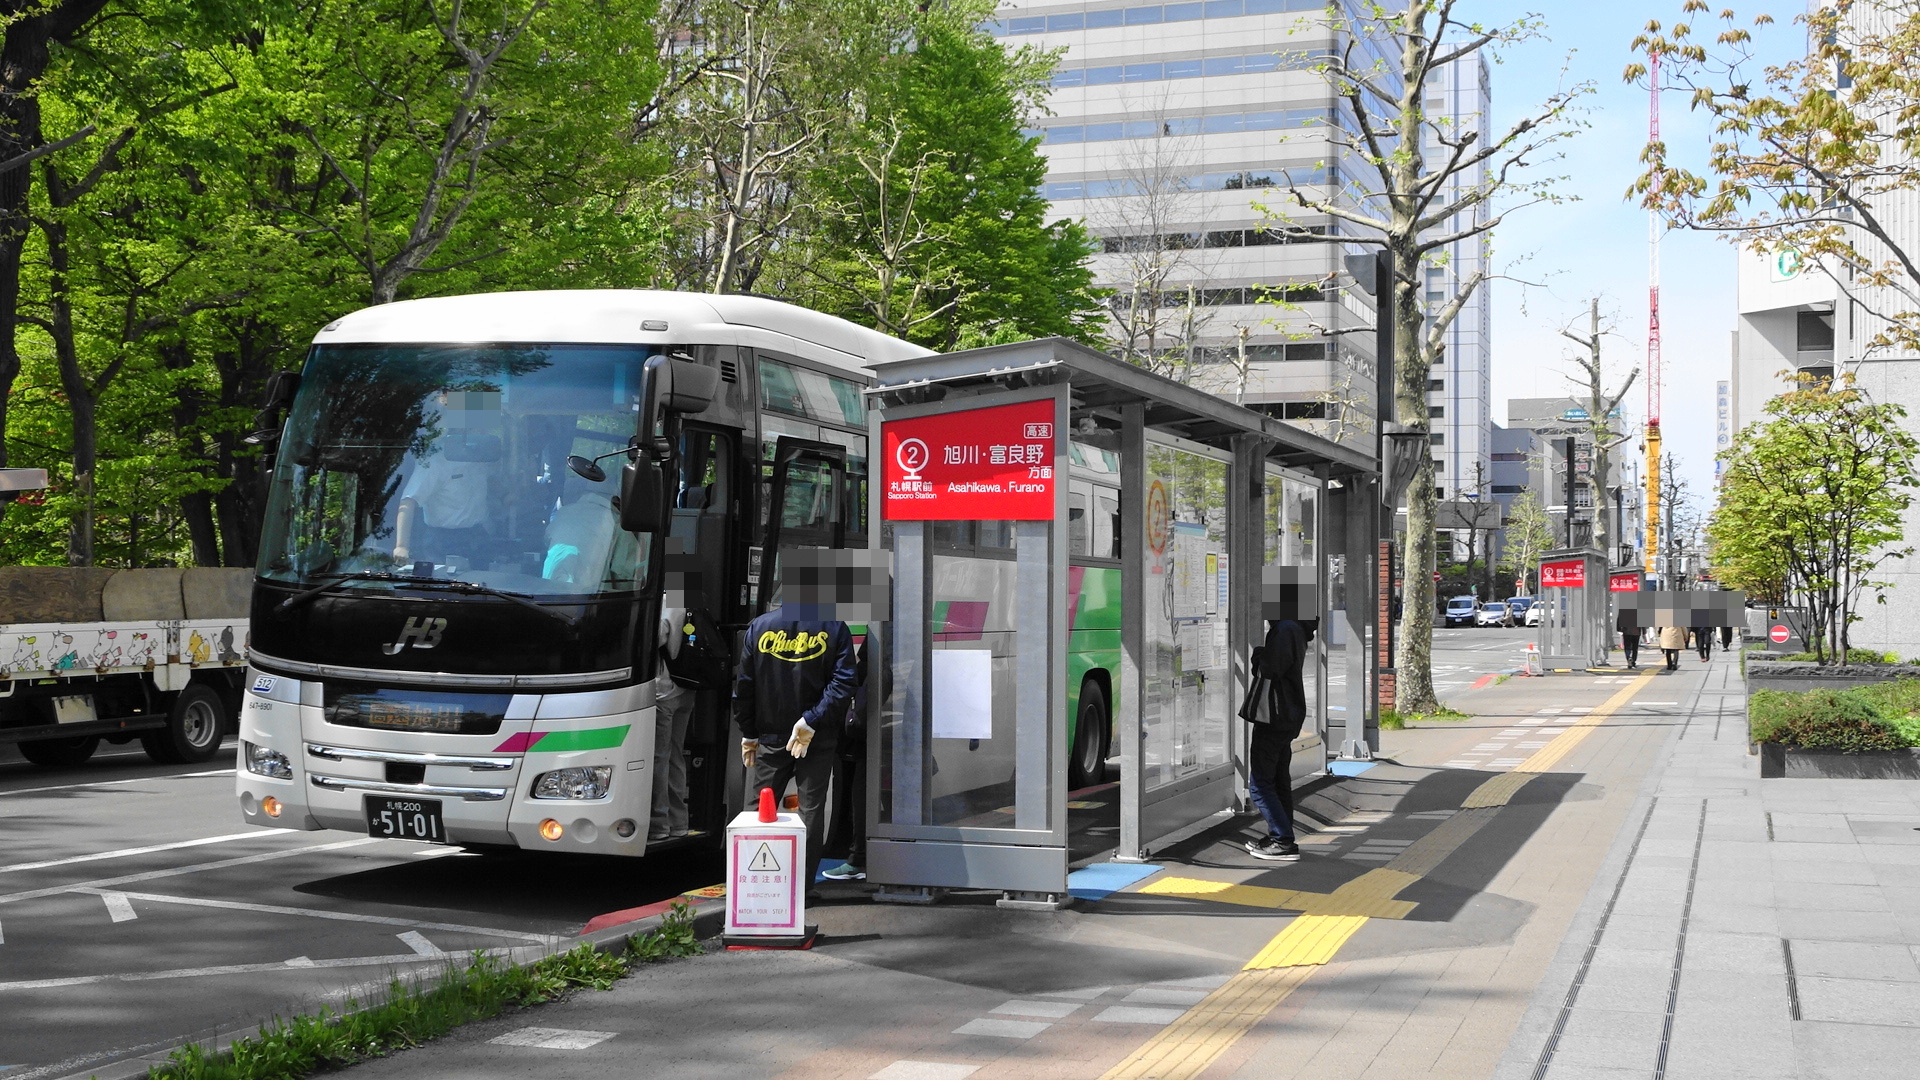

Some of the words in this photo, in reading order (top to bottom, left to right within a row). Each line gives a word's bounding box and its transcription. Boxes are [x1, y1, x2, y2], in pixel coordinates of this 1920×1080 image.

[1026, 424, 1050, 437] 高速
[907, 446, 918, 464] 2
[943, 444, 1044, 465] 旭川・富良野
[1028, 466, 1052, 479] 方面
[890, 481, 933, 492] 札幌駅前
[1008, 481, 1045, 493] Furano
[888, 492, 914, 500] Sapporo
[914, 491, 937, 499] Station
[257, 678, 272, 689] 512
[380, 810, 437, 838] 51-01
